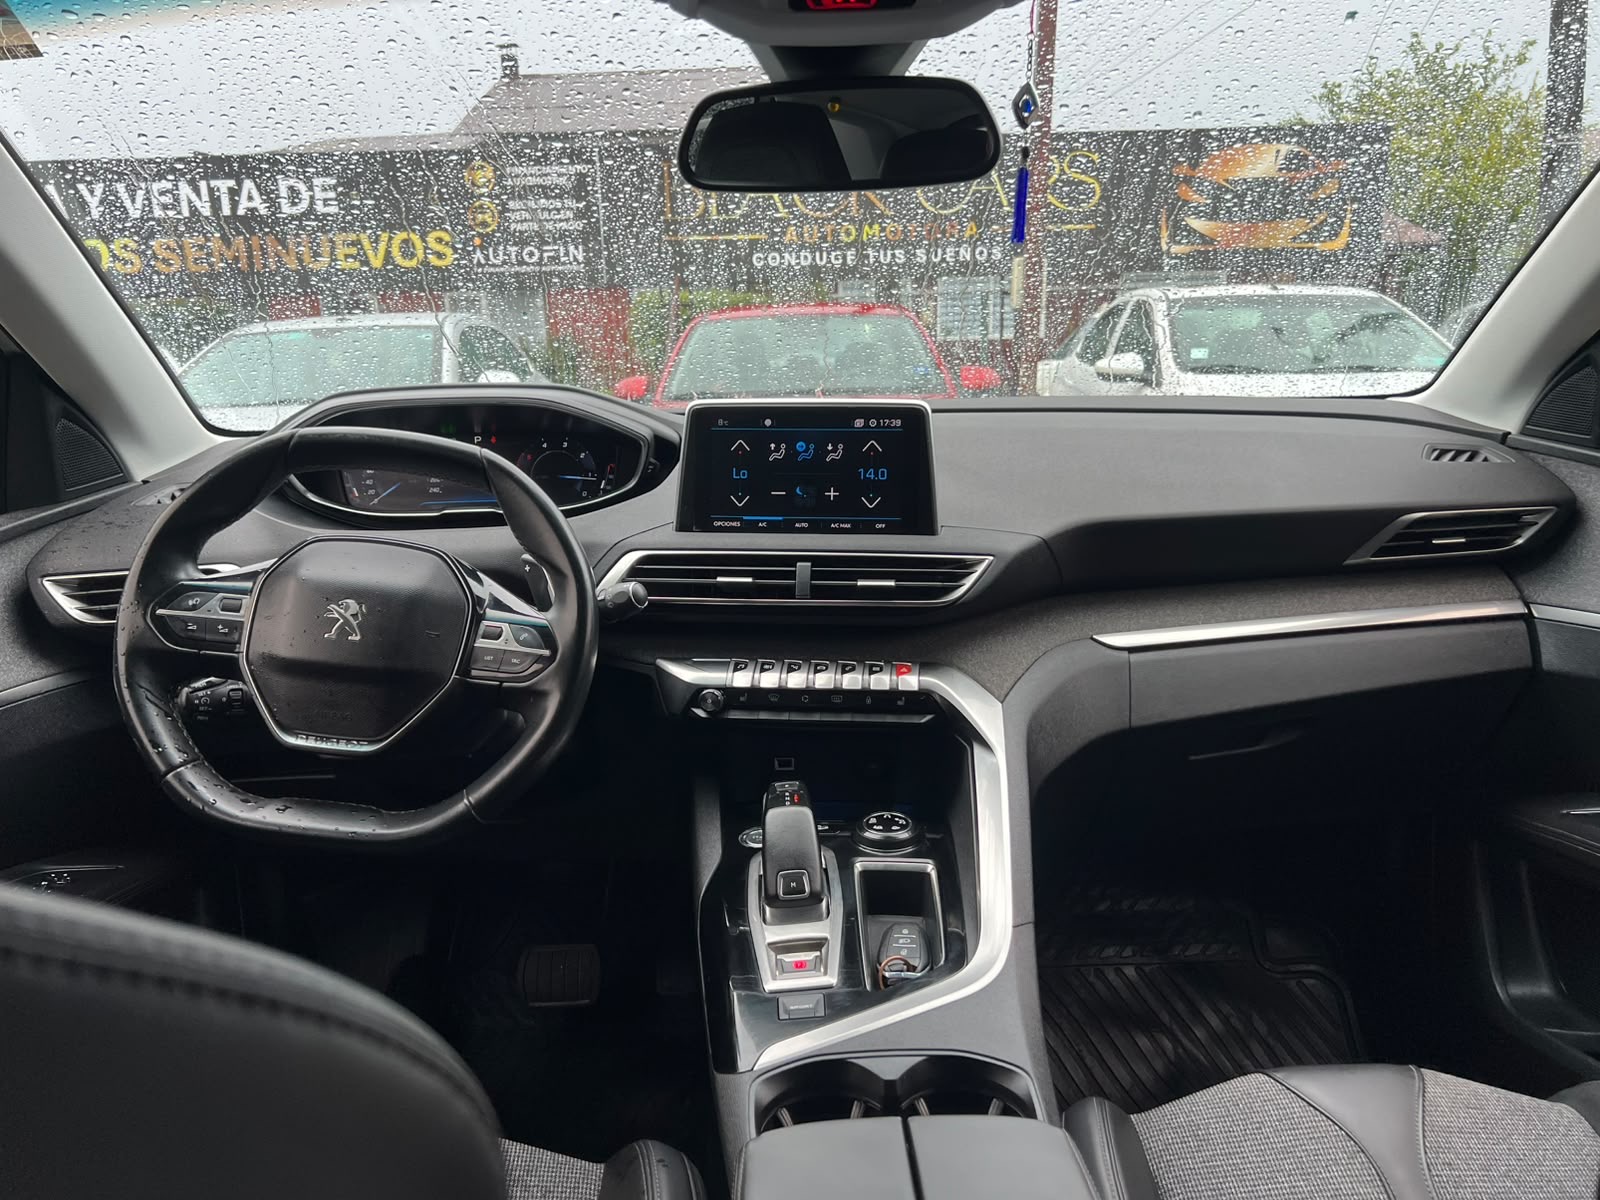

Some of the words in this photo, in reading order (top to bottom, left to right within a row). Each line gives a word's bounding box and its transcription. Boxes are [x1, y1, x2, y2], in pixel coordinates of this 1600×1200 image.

[76, 182, 105, 219] Y
[115, 178, 268, 219] VENTA
[276, 176, 340, 215] DE
[784, 220, 979, 244] AUTOMOTORA
[153, 229, 455, 274] SEMINUEVOS
[473, 244, 584, 264] AUTOFIN
[865, 249, 906, 264] TUS
[474, 436, 482, 444] P
[858, 468, 888, 480] 14.0
[713, 520, 741, 528] OPCIONES
